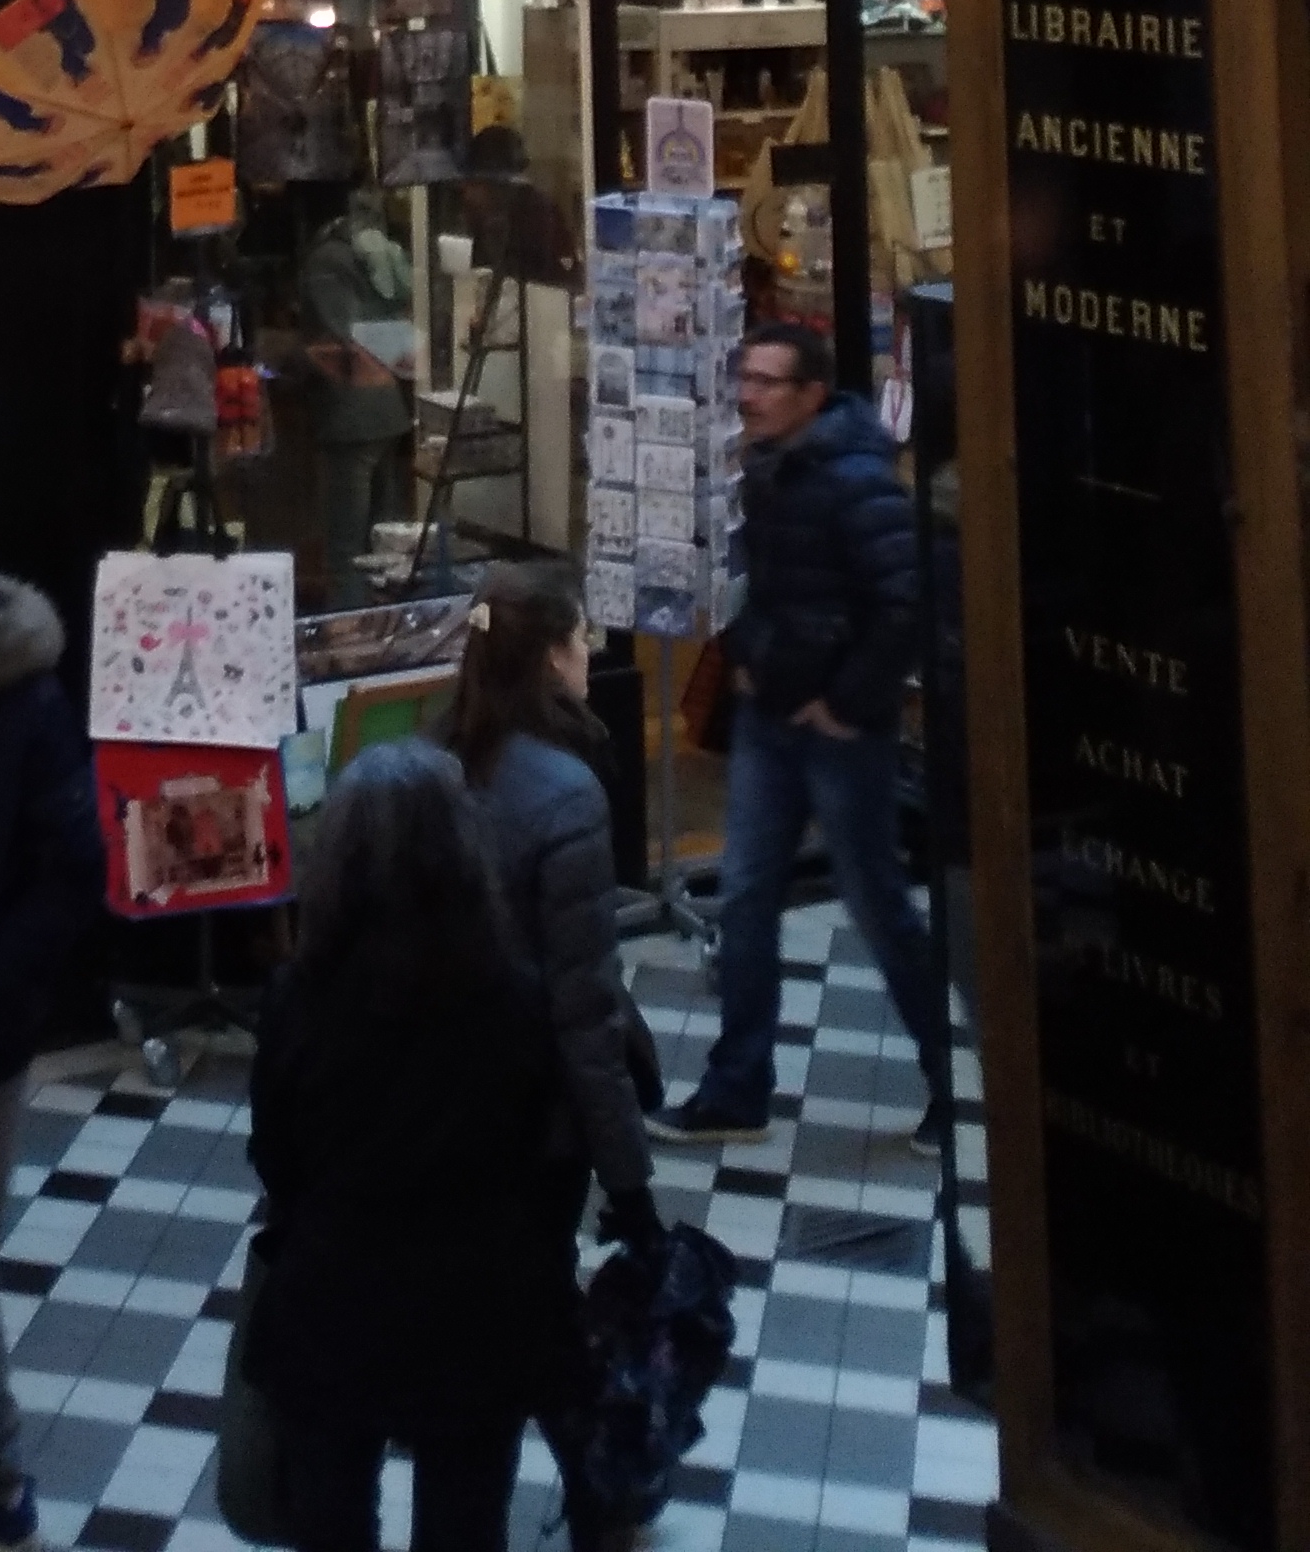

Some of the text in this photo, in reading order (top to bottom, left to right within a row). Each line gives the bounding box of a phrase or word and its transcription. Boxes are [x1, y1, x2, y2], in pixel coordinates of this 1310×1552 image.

[1010, 2, 1203, 59] LIBRAIRIE
[1016, 111, 1205, 176] ANCIENNE
[1090, 213, 1128, 245] ET
[1023, 278, 1208, 353] MODERNE
[1064, 624, 1190, 697] VENTE
[1073, 732, 1191, 801] ACHAT
[1101, 941, 1225, 1023] LIVRES
